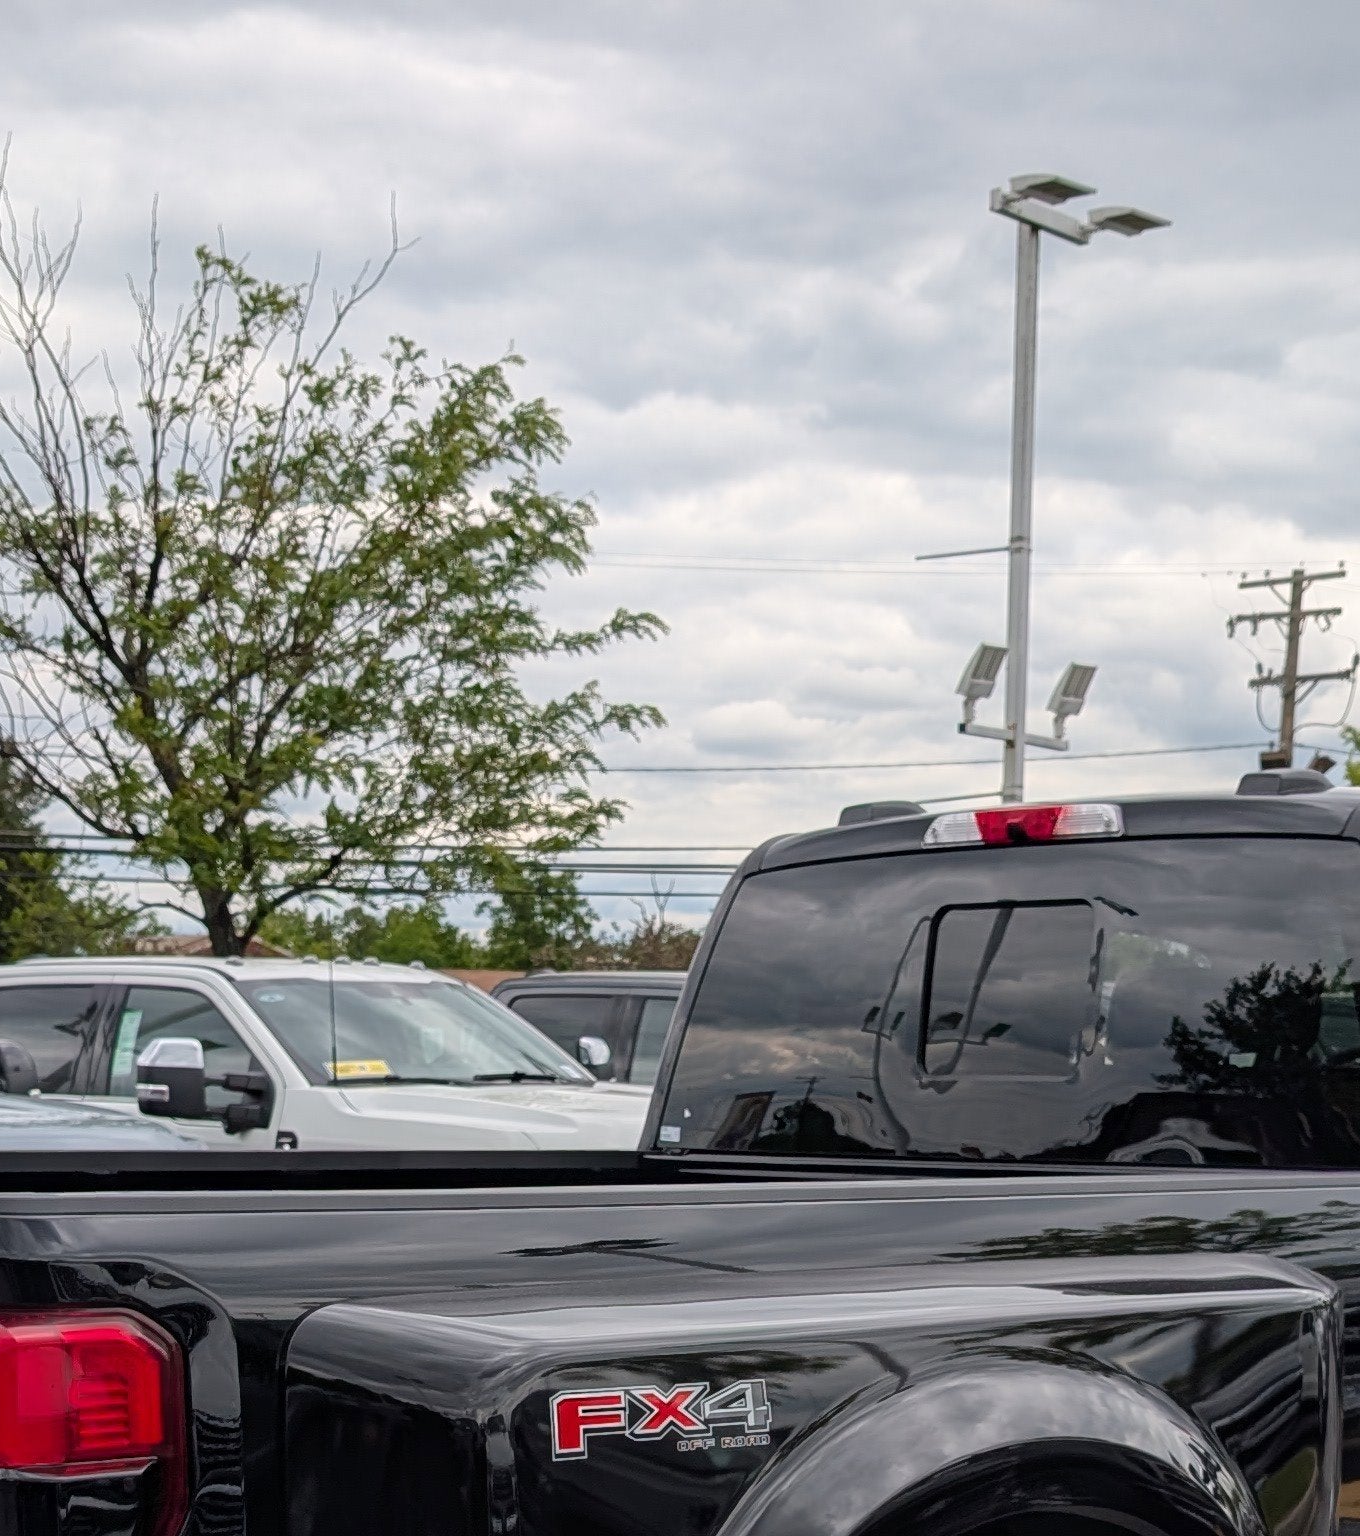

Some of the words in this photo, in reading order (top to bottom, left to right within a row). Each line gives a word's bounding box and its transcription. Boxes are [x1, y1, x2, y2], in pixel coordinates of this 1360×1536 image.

[549, 1379, 772, 1461] FX4
[677, 1437, 716, 1451] OFF
[720, 1434, 771, 1448] ROAD
